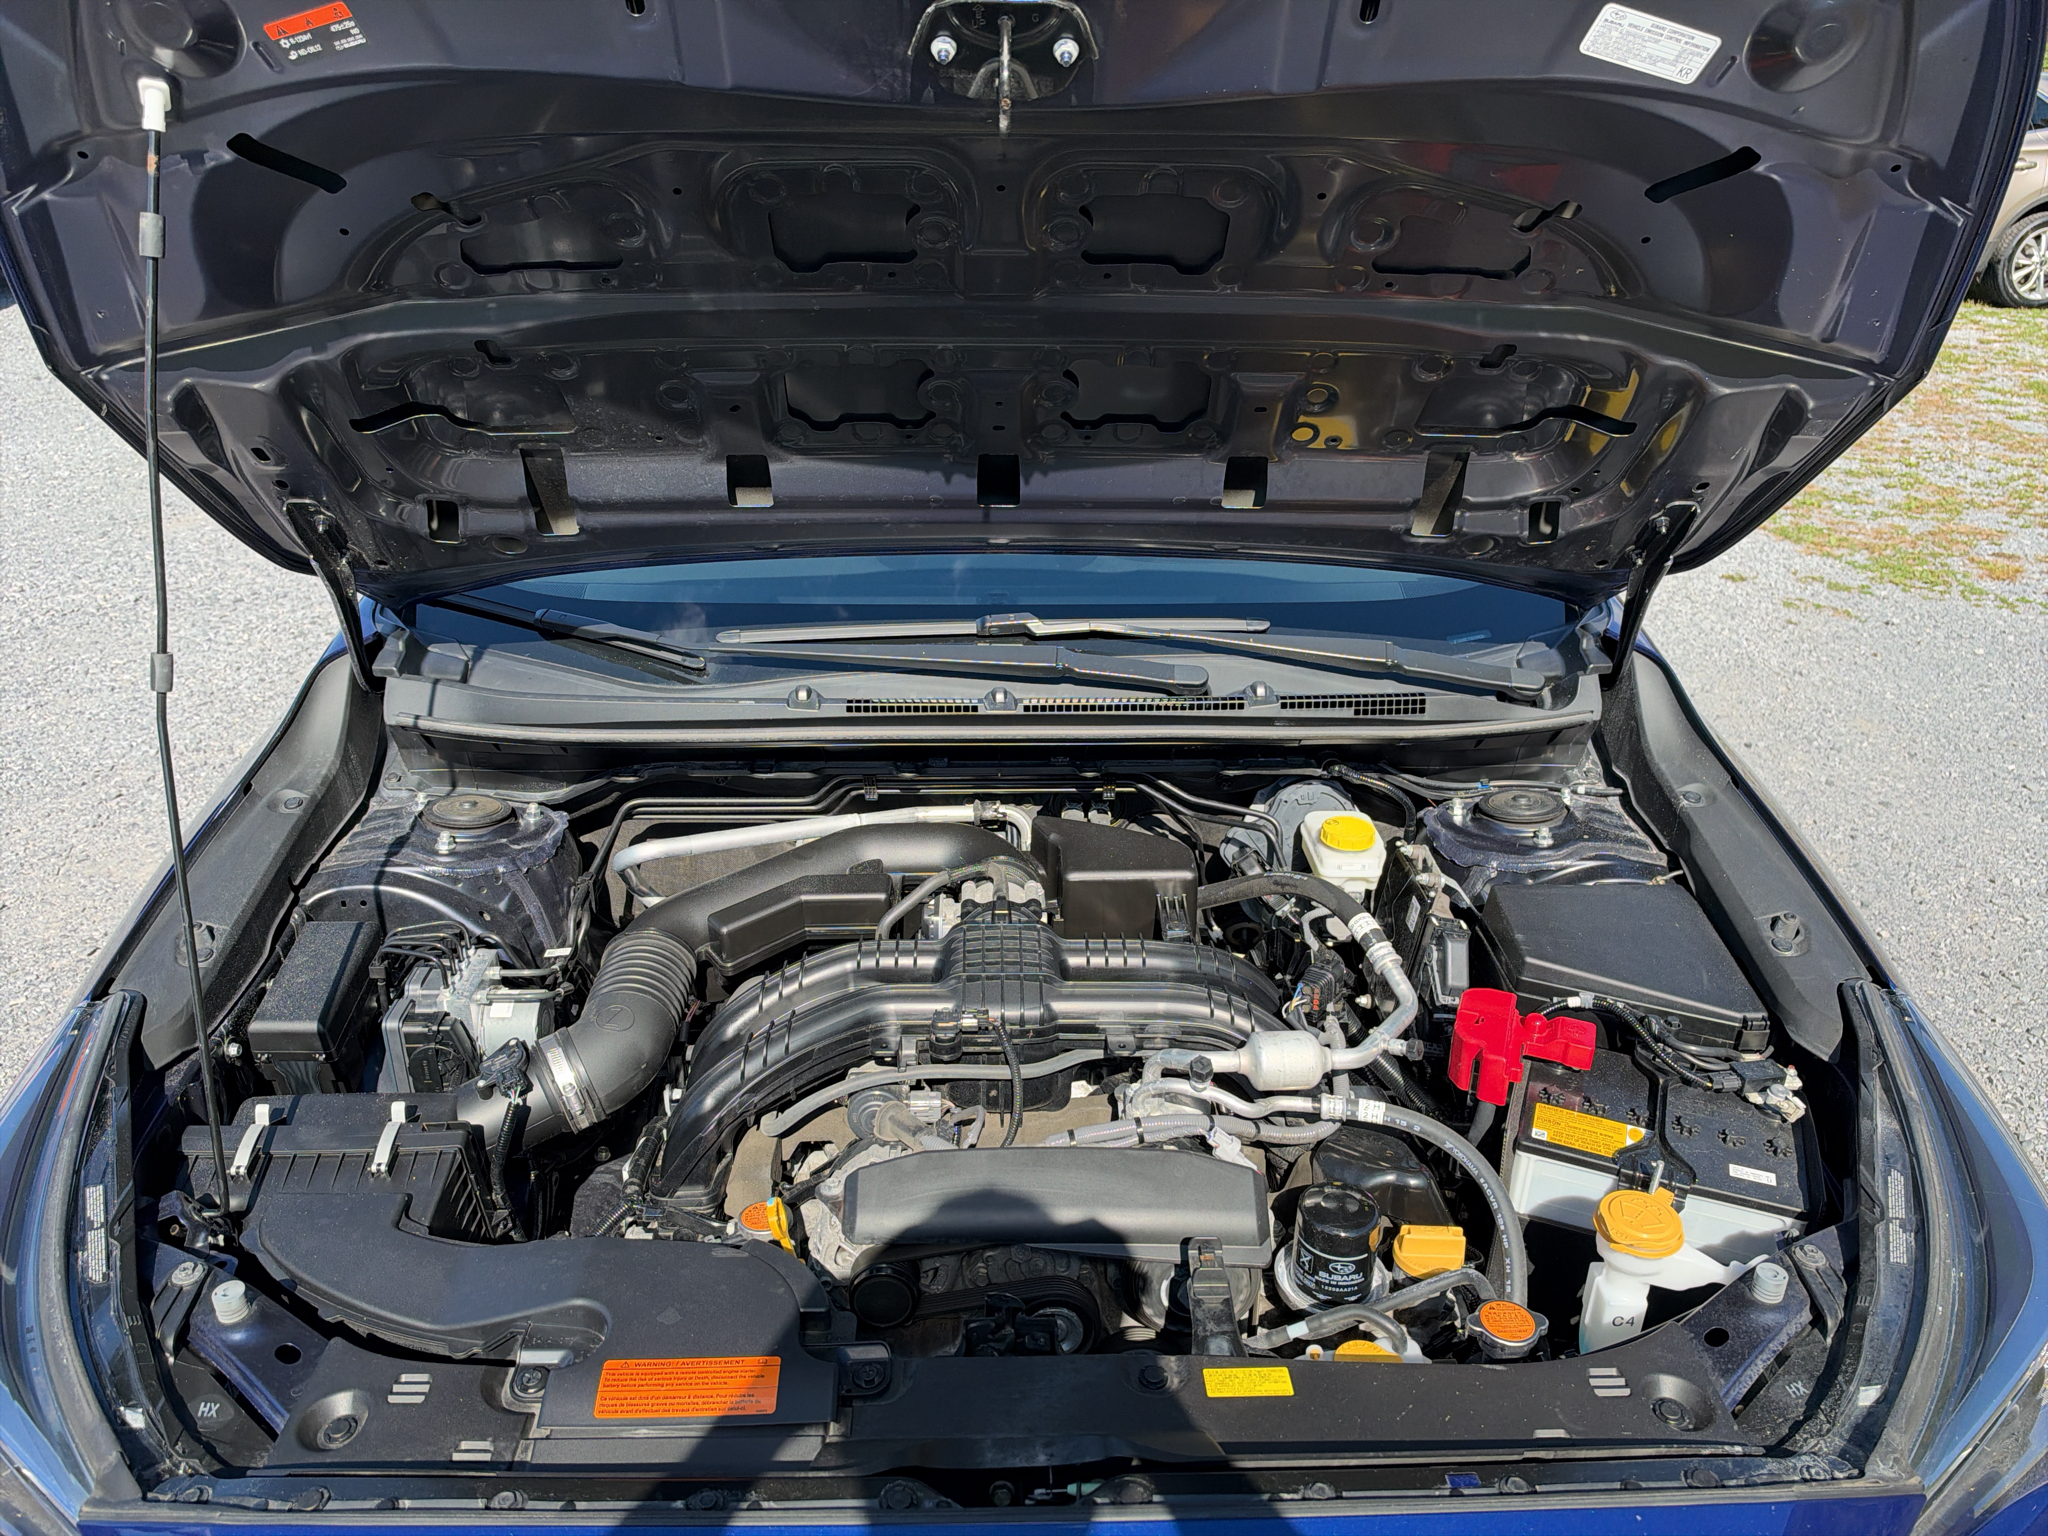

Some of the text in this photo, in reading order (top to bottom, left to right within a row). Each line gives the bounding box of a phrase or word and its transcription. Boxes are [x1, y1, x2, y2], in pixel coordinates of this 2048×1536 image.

[1676, 66, 1692, 79] KR
[1319, 1270, 1363, 1281] SUBARU
[1785, 1380, 1809, 1398] HX
[198, 1402, 220, 1418] HX
